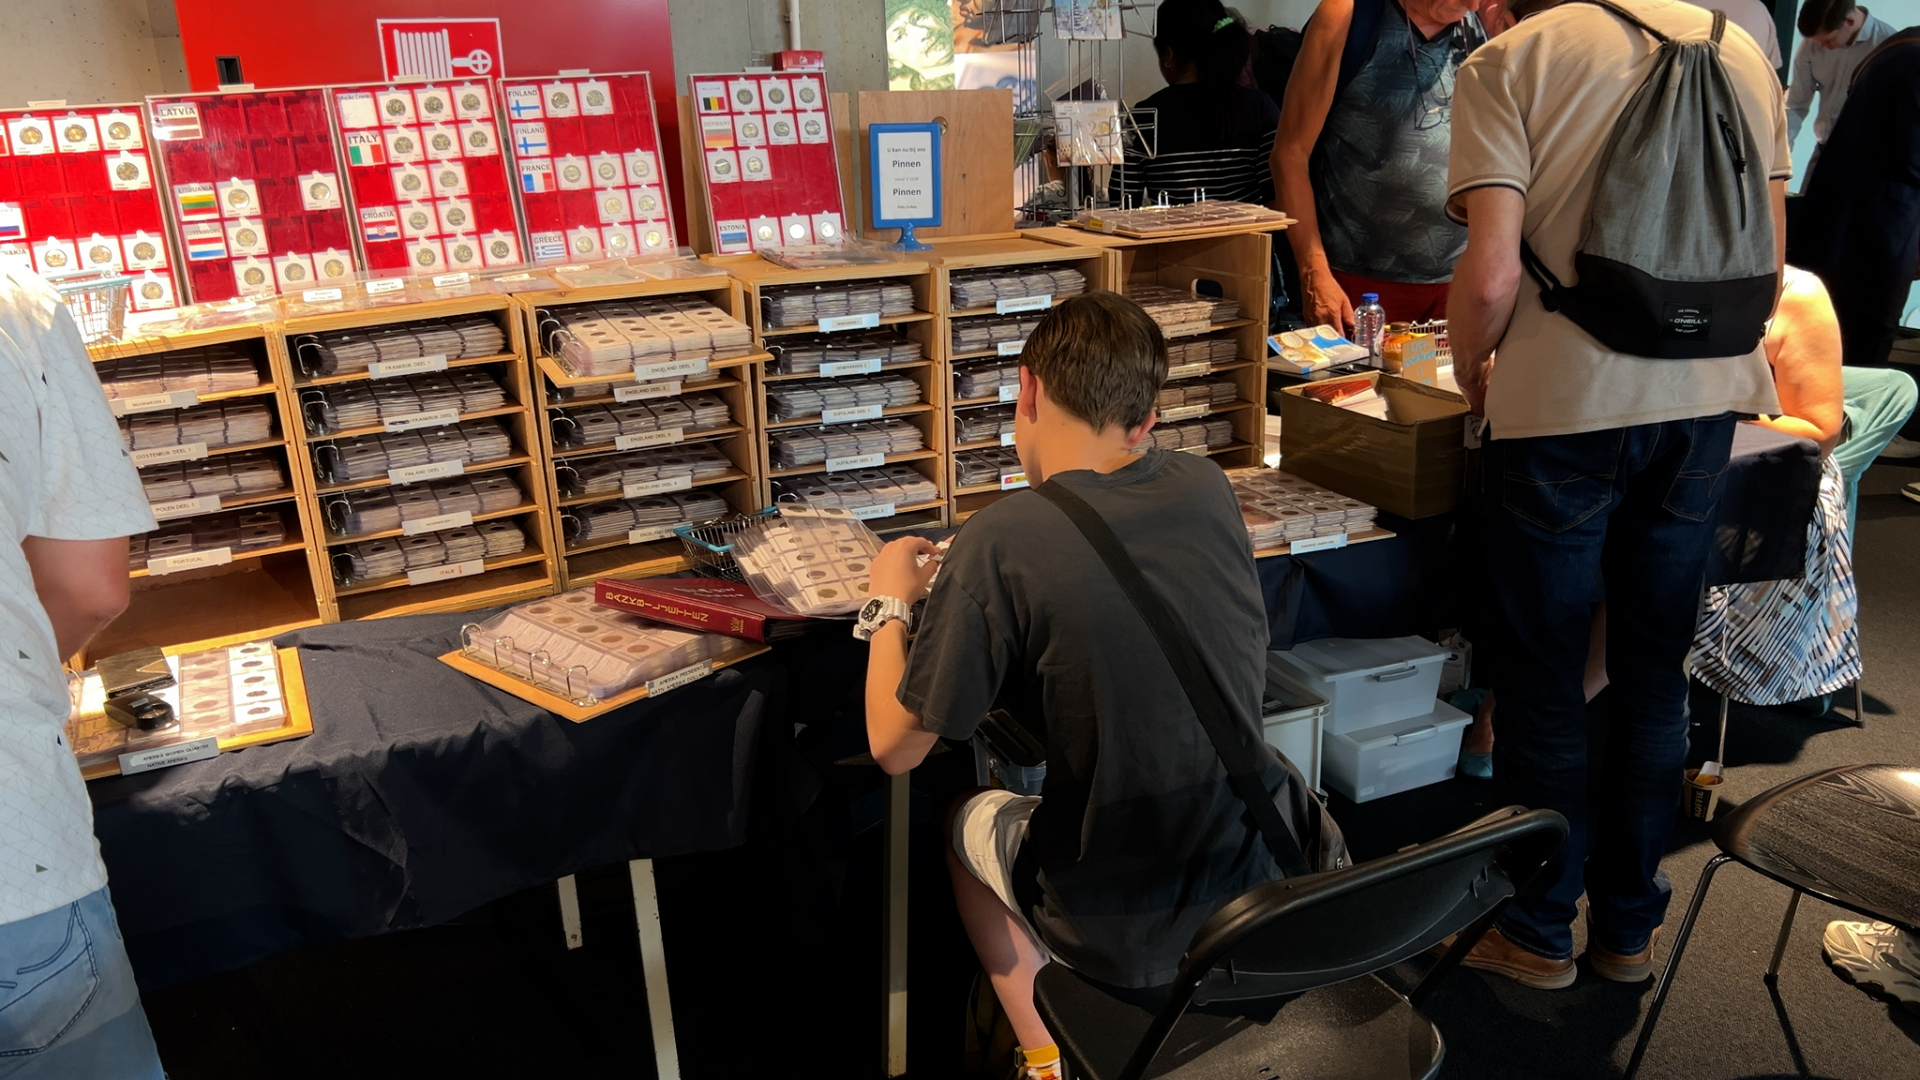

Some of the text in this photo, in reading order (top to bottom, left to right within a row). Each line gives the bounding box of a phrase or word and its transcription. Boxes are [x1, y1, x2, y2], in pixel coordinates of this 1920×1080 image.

[508, 89, 538, 97] FINLAND
[160, 107, 196, 117] LATVIA
[515, 127, 545, 135] FINLAND
[348, 134, 378, 144] ITALY
[521, 164, 551, 172] FRANCE
[892, 160, 921, 168] Pinnen
[178, 185, 214, 194] LITHUANIA
[893, 188, 922, 196] Pinnen
[362, 211, 395, 219] CROATIA
[719, 224, 746, 232] ESTONIA
[533, 235, 563, 244] GREECE
[385, 362, 412, 371] FRANKRIJK
[651, 365, 677, 374] ENGELAND
[625, 388, 649, 396] ENGELAND
[132, 399, 162, 408] NOORWEGEN
[833, 409, 856, 417] DUITSLAND
[412, 414, 439, 423] FRANKRIJK
[630, 434, 655, 442] ENGELAND
[136, 449, 171, 460] OOSTENRIJK
[404, 469, 427, 477] FINLAND
[637, 483, 661, 491] ENGELAND
[156, 504, 175, 512] POLEN
[640, 530, 664, 538] ENGELAND
[173, 556, 204, 565] PORTUGAL
[605, 591, 709, 623] BANKBILJETTEN
[659, 664, 704, 686] AMERIKA PRESIDENT
[651, 671, 705, 696] NATIV AMERIKA DOLLAR
[143, 744, 209, 761] AMERIKA WOMEN QUARTER
[147, 756, 188, 768] NATIVE AMERIKA
[1694, 790, 1704, 818] KOFFIE
